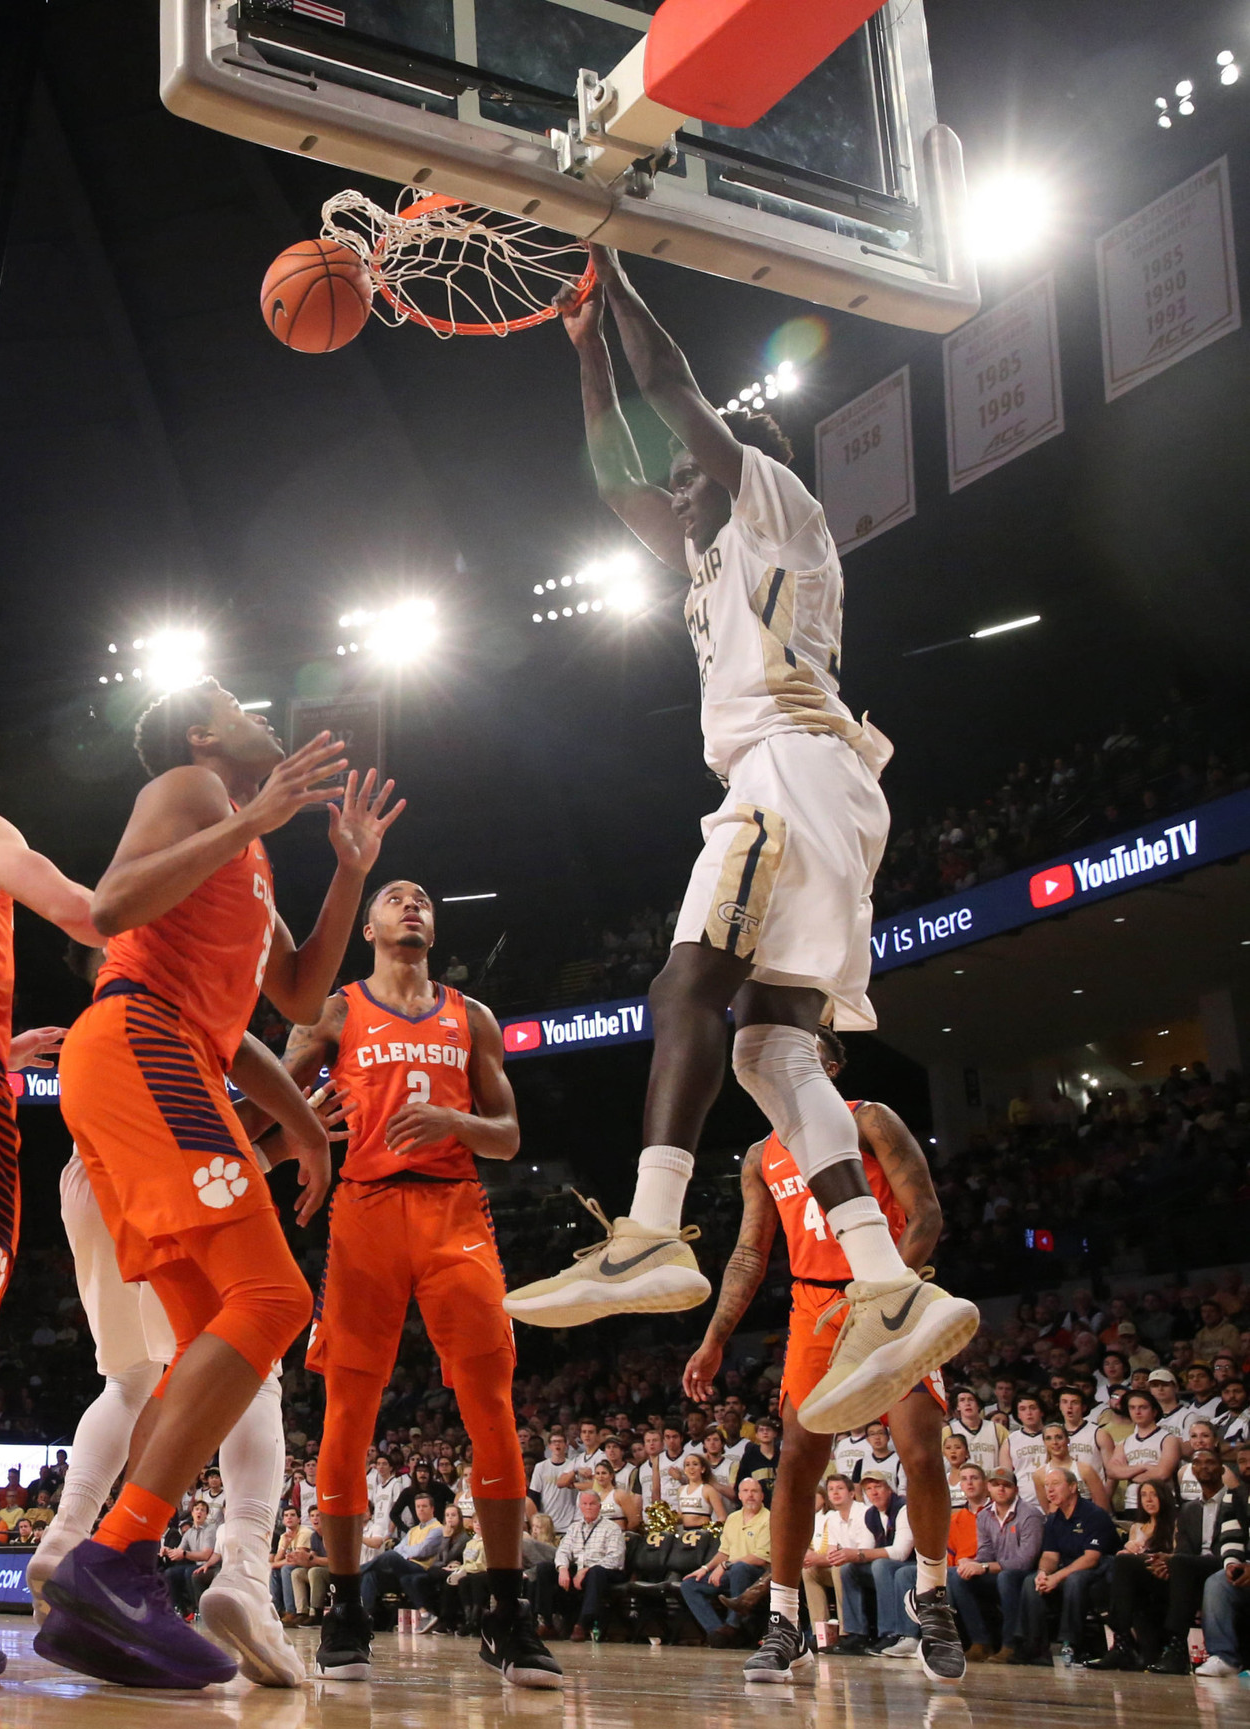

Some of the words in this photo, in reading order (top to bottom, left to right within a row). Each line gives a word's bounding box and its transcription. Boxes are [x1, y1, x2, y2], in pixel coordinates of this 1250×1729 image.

[1142, 245, 1184, 283] 1985
[1145, 271, 1187, 308] 1990
[1147, 297, 1187, 335] 1993
[1143, 316, 1198, 362] ACC
[976, 351, 1023, 395] 1985
[978, 383, 1025, 429] 1996
[843, 424, 882, 465] 1938
[980, 418, 1028, 459] ACC
[893, 926, 913, 952] is
[919, 908, 972, 944] here
[357, 1042, 468, 1071] CLEMSON
[407, 1071, 430, 1104] 2
[803, 1197, 827, 1241] 4
[1032, 1456, 1041, 1468] 4
